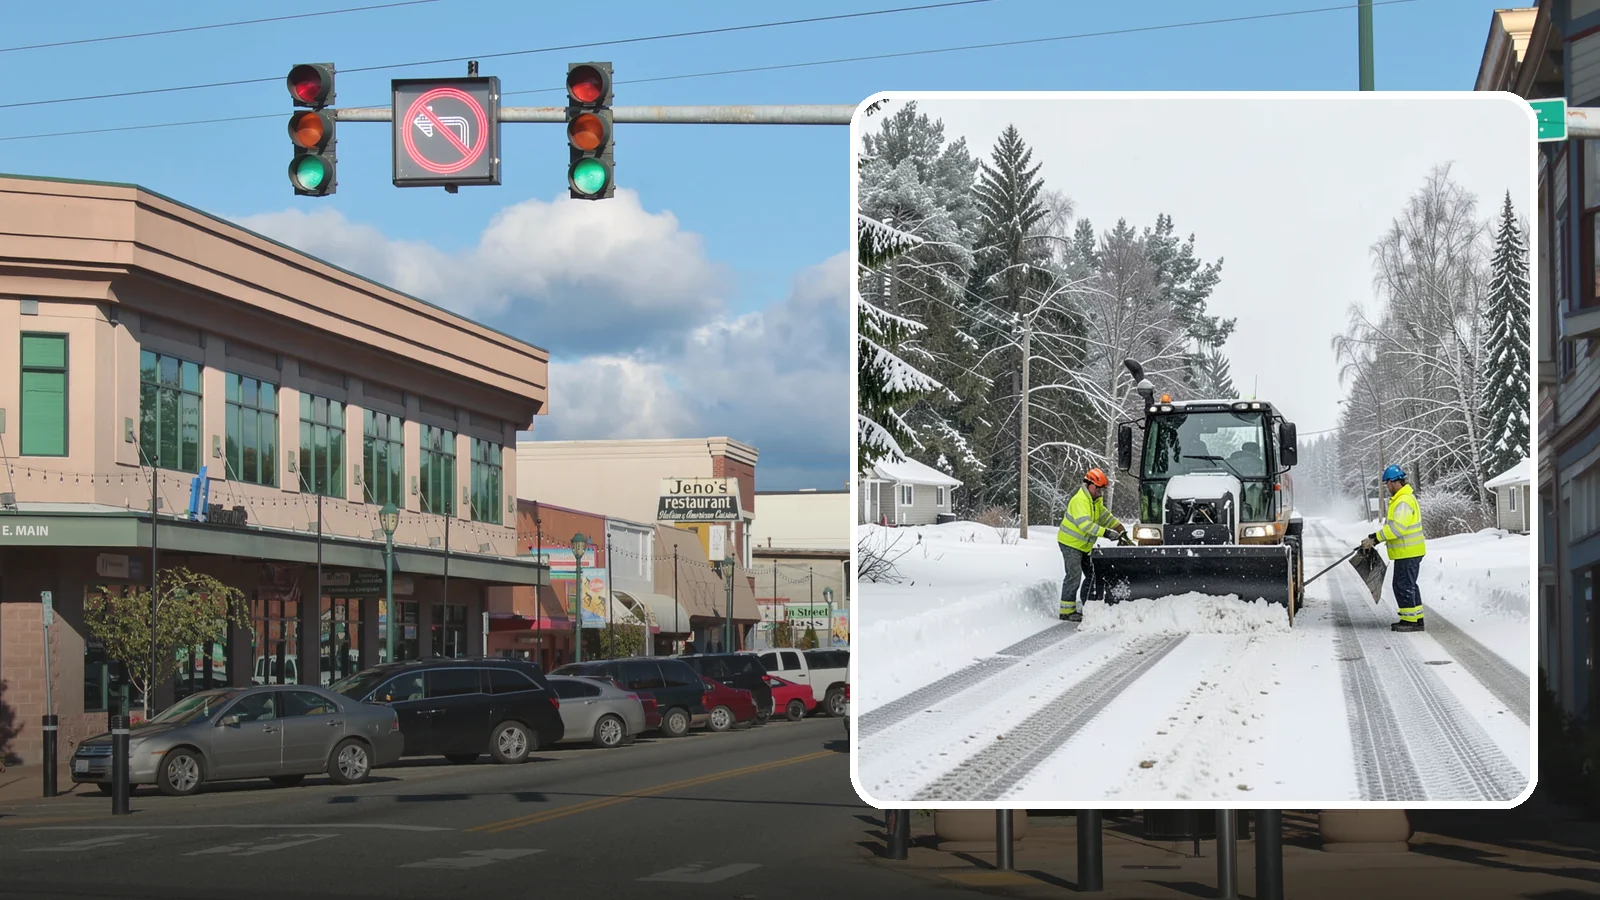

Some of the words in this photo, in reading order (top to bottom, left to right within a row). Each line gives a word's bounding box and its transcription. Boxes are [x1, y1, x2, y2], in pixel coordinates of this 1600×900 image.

[669, 480, 727, 494] Jeno's
[665, 496, 731, 509] restaurant
[658, 509, 681, 519] Italian
[686, 509, 714, 519] American
[715, 509, 738, 519] Cuisine
[2, 525, 13, 536] E.
[15, 525, 49, 536] MAIN
[797, 607, 828, 617] Street
